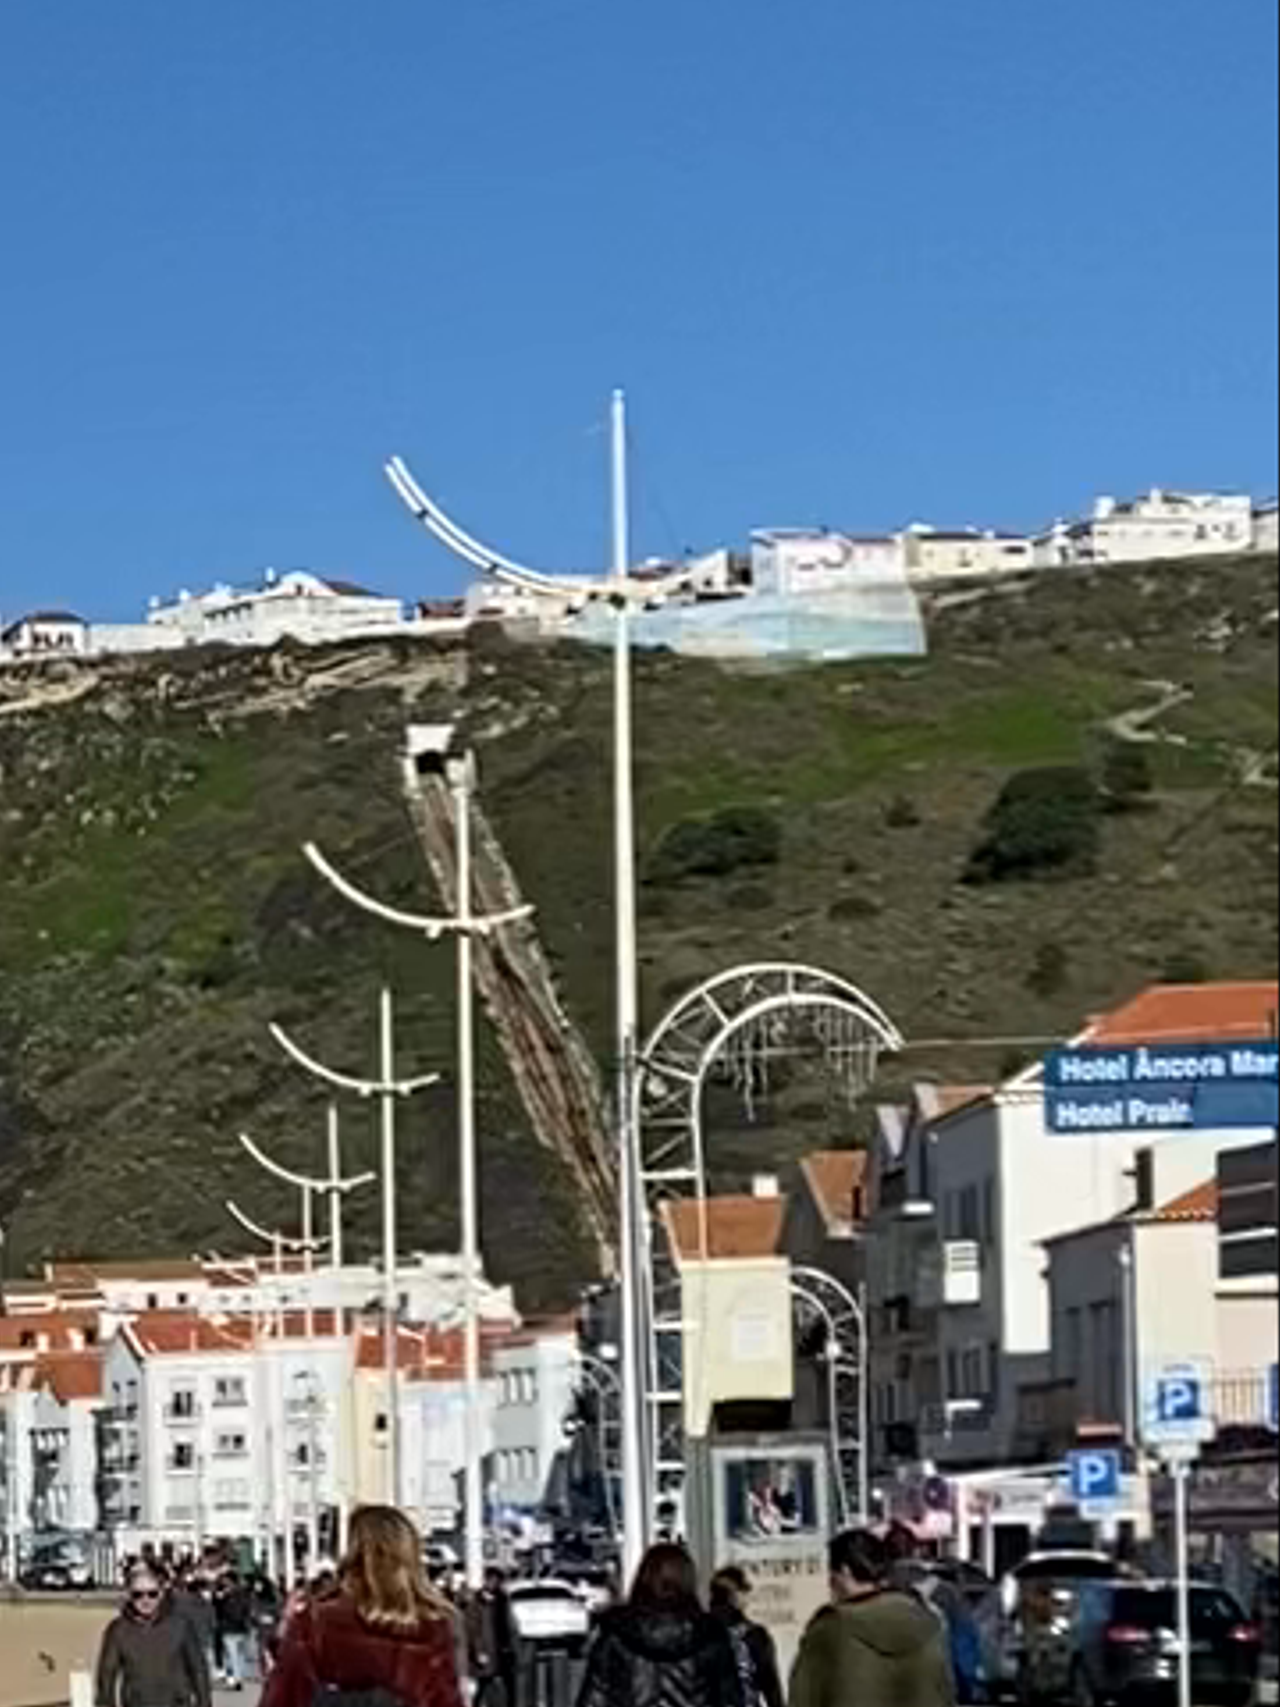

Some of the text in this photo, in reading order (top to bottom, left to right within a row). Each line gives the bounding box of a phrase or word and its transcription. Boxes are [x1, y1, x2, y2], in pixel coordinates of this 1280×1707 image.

[1059, 1054, 1128, 1081] Hotel
[1057, 1100, 1123, 1126] Hotel
[1163, 1382, 1190, 1416] P
[1079, 1455, 1108, 1494] P
